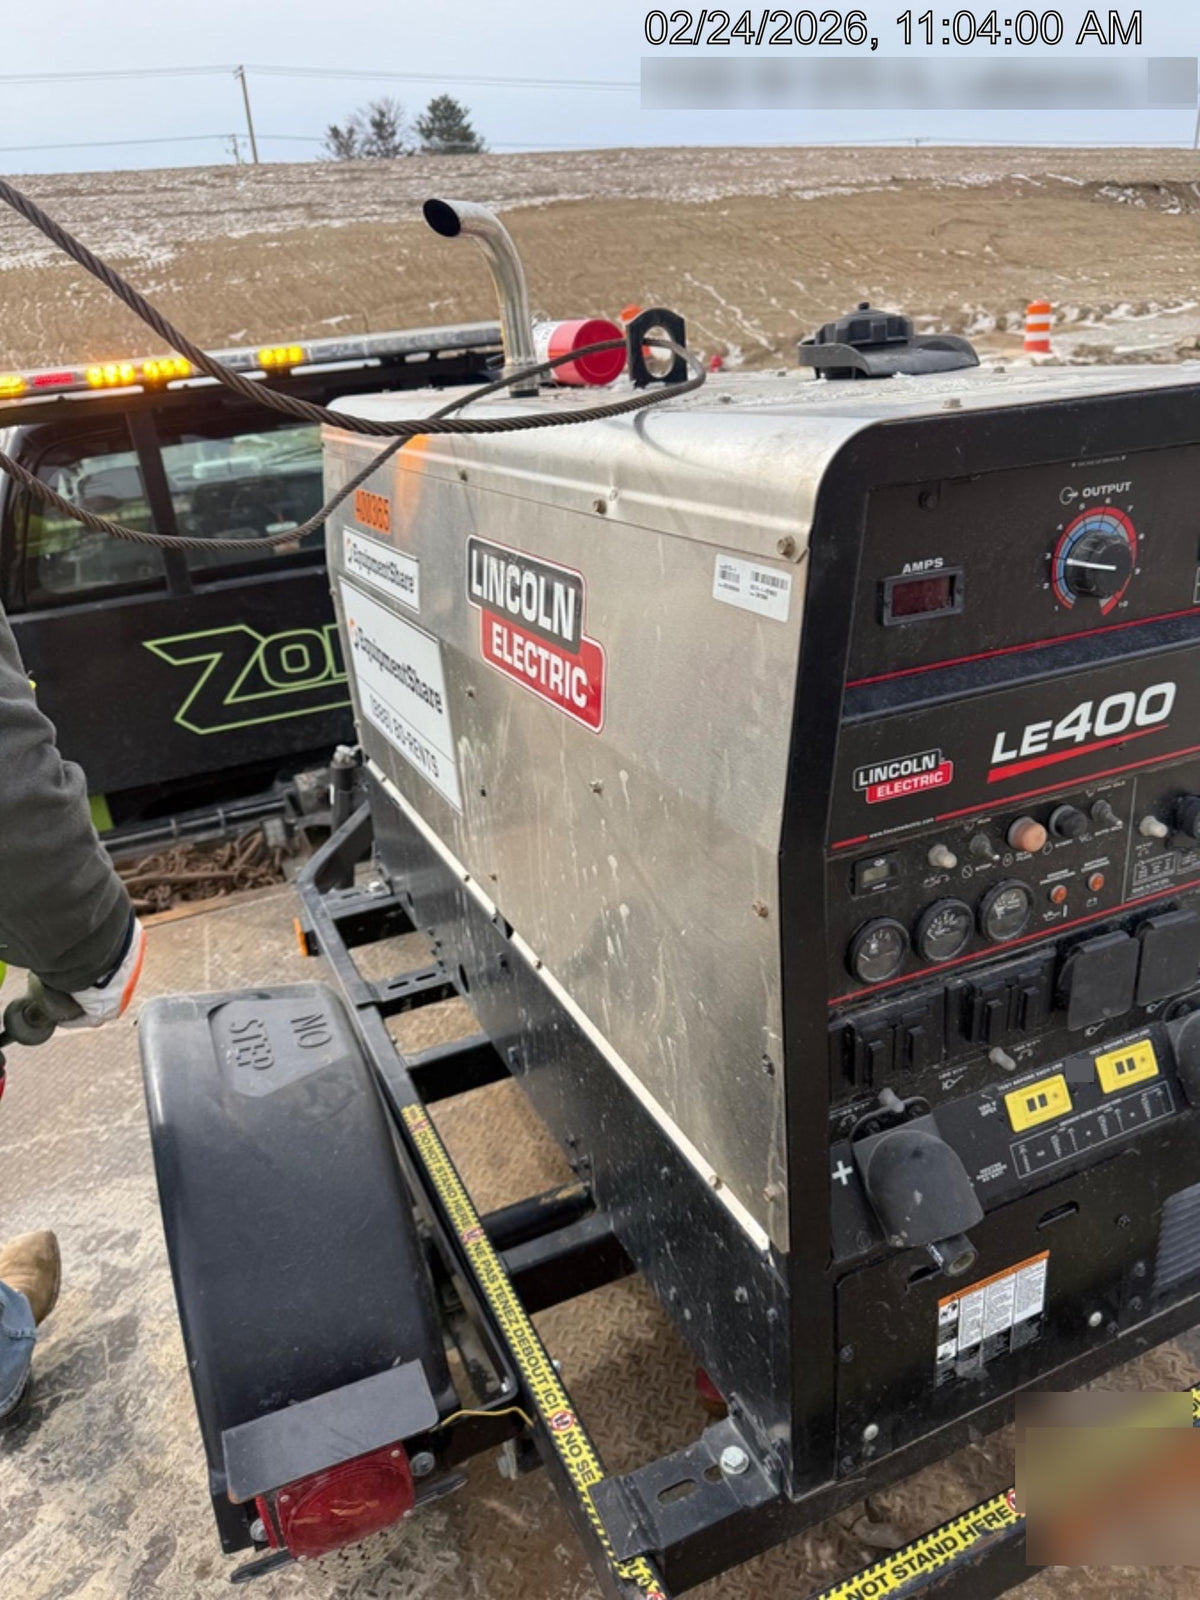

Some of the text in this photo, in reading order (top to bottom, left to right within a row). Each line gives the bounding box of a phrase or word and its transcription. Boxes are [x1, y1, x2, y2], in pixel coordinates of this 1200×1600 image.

[1081, 480, 1132, 498] OUTPUT
[902, 557, 944, 576] AMPS
[472, 548, 576, 643] LINCOLN
[492, 621, 588, 708] ELECTRIC
[991, 681, 1176, 764] LE400
[858, 753, 936, 787] LINCOLN
[876, 771, 944, 798] ELECTRIC
[418, 1130, 473, 1229] DO NOT STAND HERE
[474, 1241, 561, 1410] NE PAS TENEZ DEBOUT ICI
[562, 1431, 596, 1484] NO SE
[890, 1536, 958, 1581] STAND
